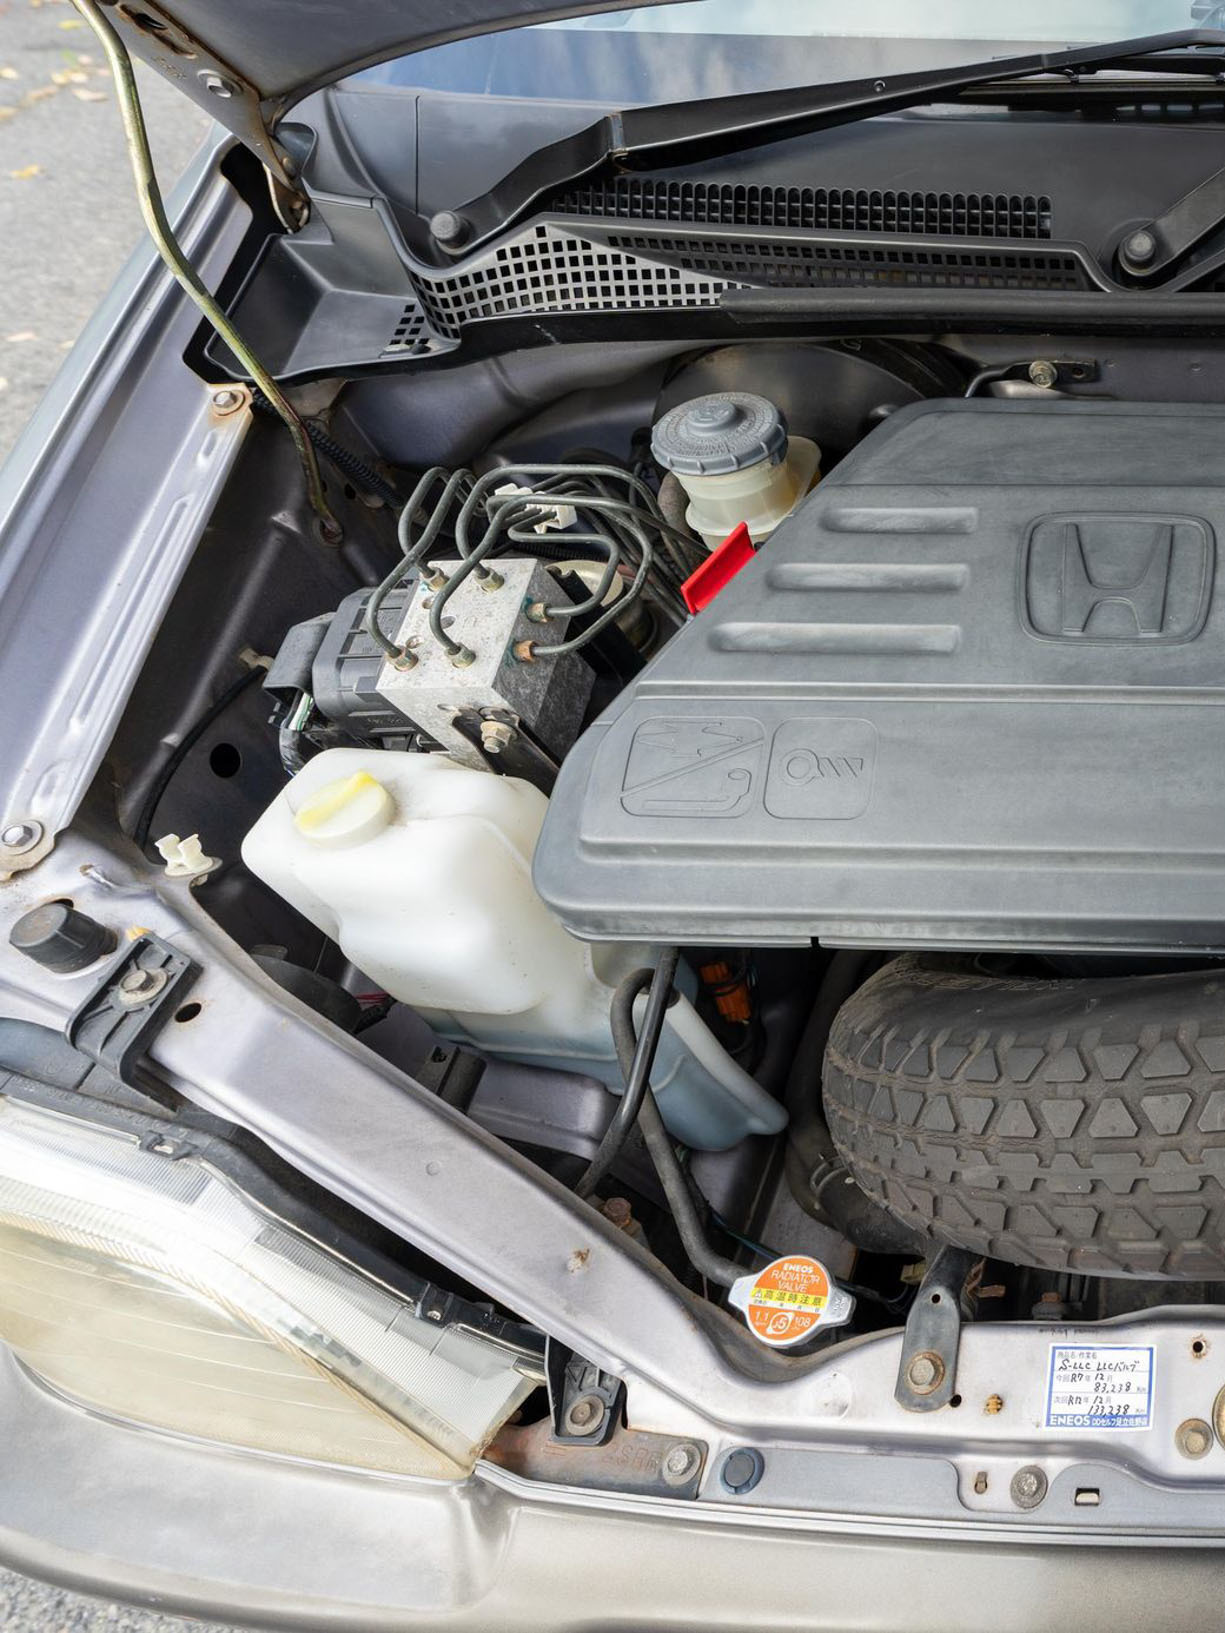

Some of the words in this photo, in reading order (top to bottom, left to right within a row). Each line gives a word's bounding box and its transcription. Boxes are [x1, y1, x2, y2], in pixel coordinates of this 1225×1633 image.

[784, 1263, 814, 1272] ENEOS
[771, 1270, 820, 1284] RADIATOR
[778, 1281, 807, 1292] VALVE
[1059, 1359, 1091, 1371] S-LLC
[1071, 1373, 1083, 1382] R7
[1095, 1373, 1104, 1381] 12
[1094, 1382, 1131, 1393] 83,238
[1093, 1395, 1103, 1404] 12
[1088, 1404, 1130, 1416] 133,238
[1050, 1416, 1090, 1425] ENEOS
